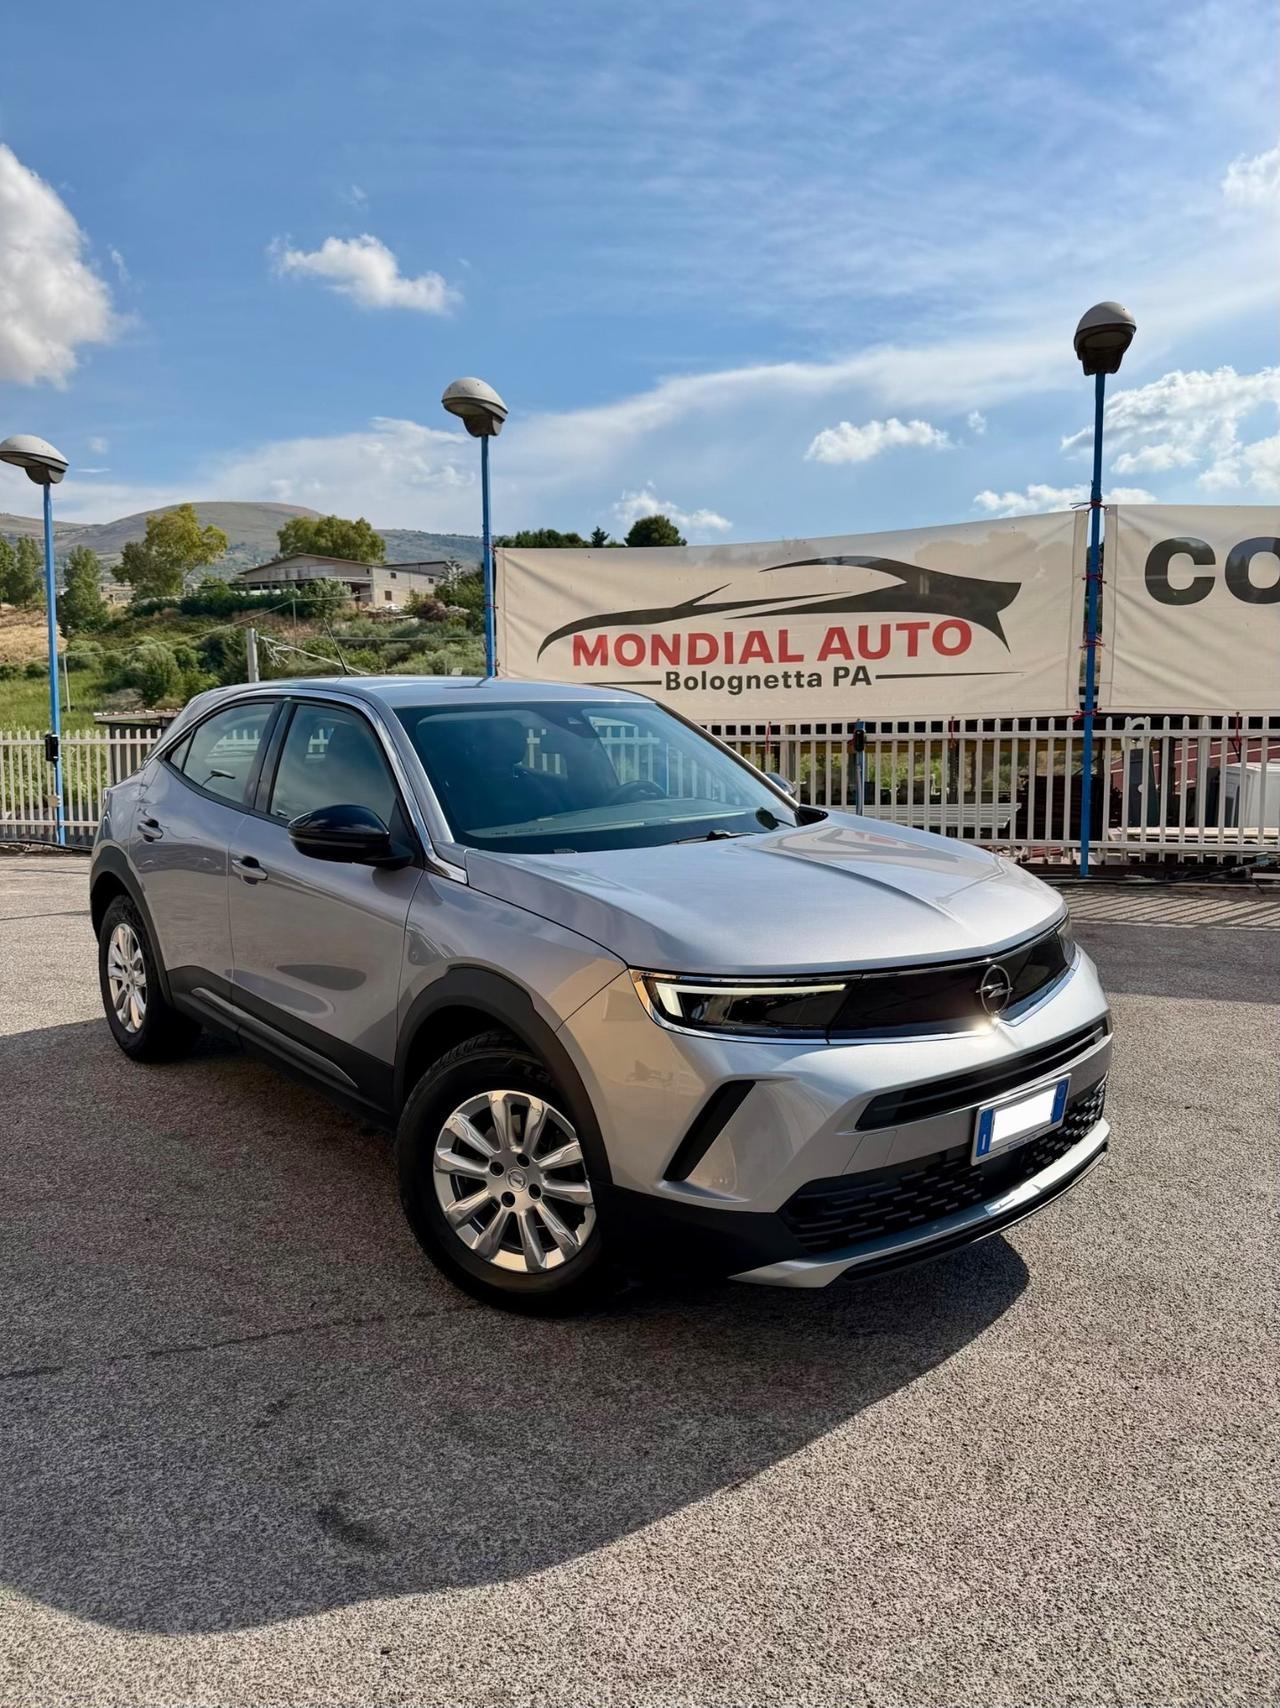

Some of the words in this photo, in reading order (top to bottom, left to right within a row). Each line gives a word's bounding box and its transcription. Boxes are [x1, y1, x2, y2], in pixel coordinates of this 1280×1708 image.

[572, 629, 804, 667] MONDIAL
[816, 619, 972, 663] AUTO
[665, 669, 823, 696] Bolognetta
[833, 665, 872, 687] PA
